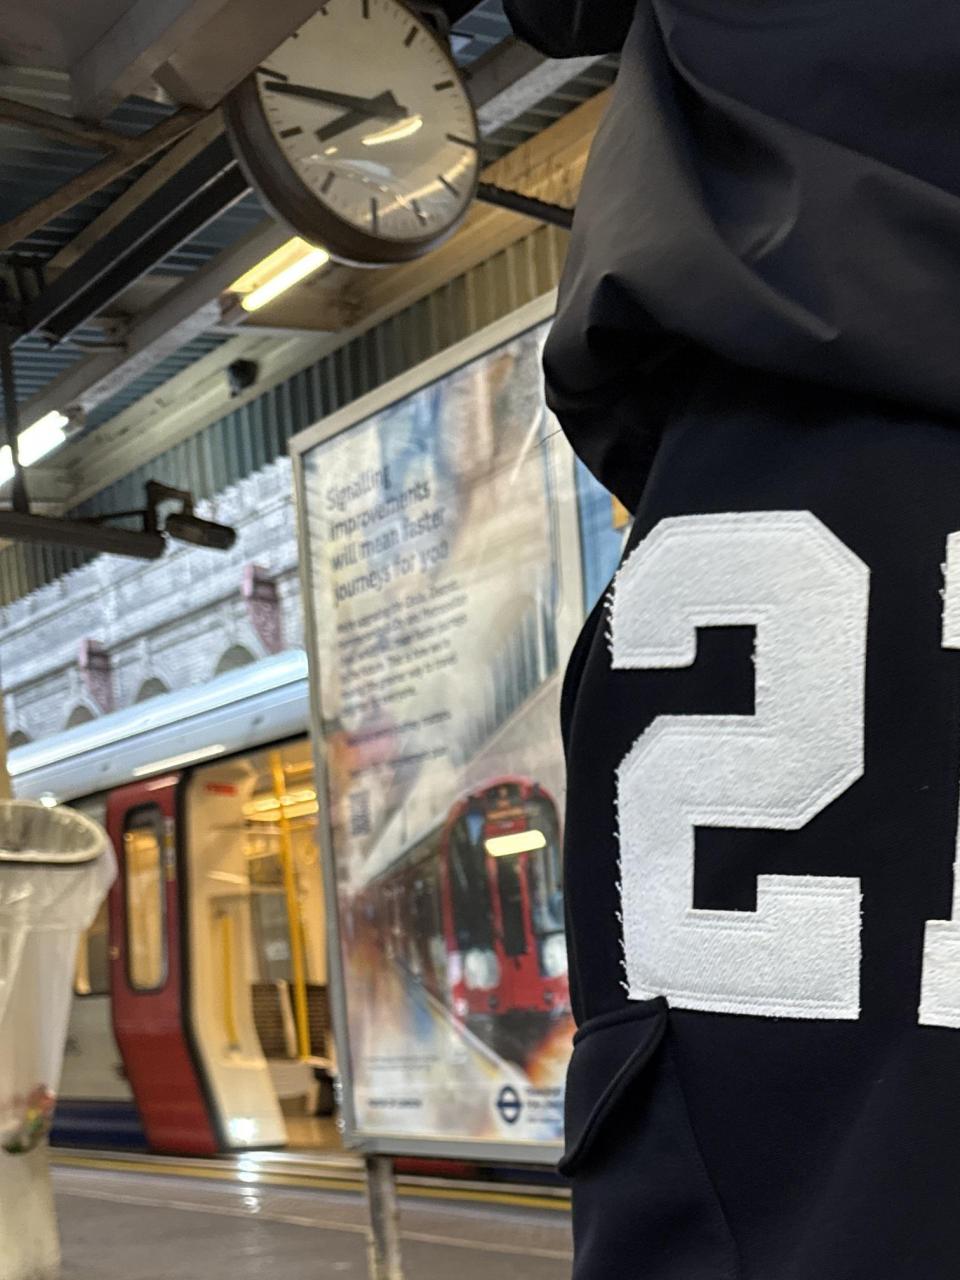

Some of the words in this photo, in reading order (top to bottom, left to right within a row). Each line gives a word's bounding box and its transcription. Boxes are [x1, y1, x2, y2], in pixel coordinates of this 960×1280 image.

[325, 465, 392, 512] Signalling
[329, 480, 430, 541] improvements
[332, 542, 358, 571] will
[360, 528, 400, 559] mean
[402, 506, 445, 541] faster
[334, 565, 391, 609] journeys
[393, 553, 416, 576] for
[420, 540, 450, 574] you
